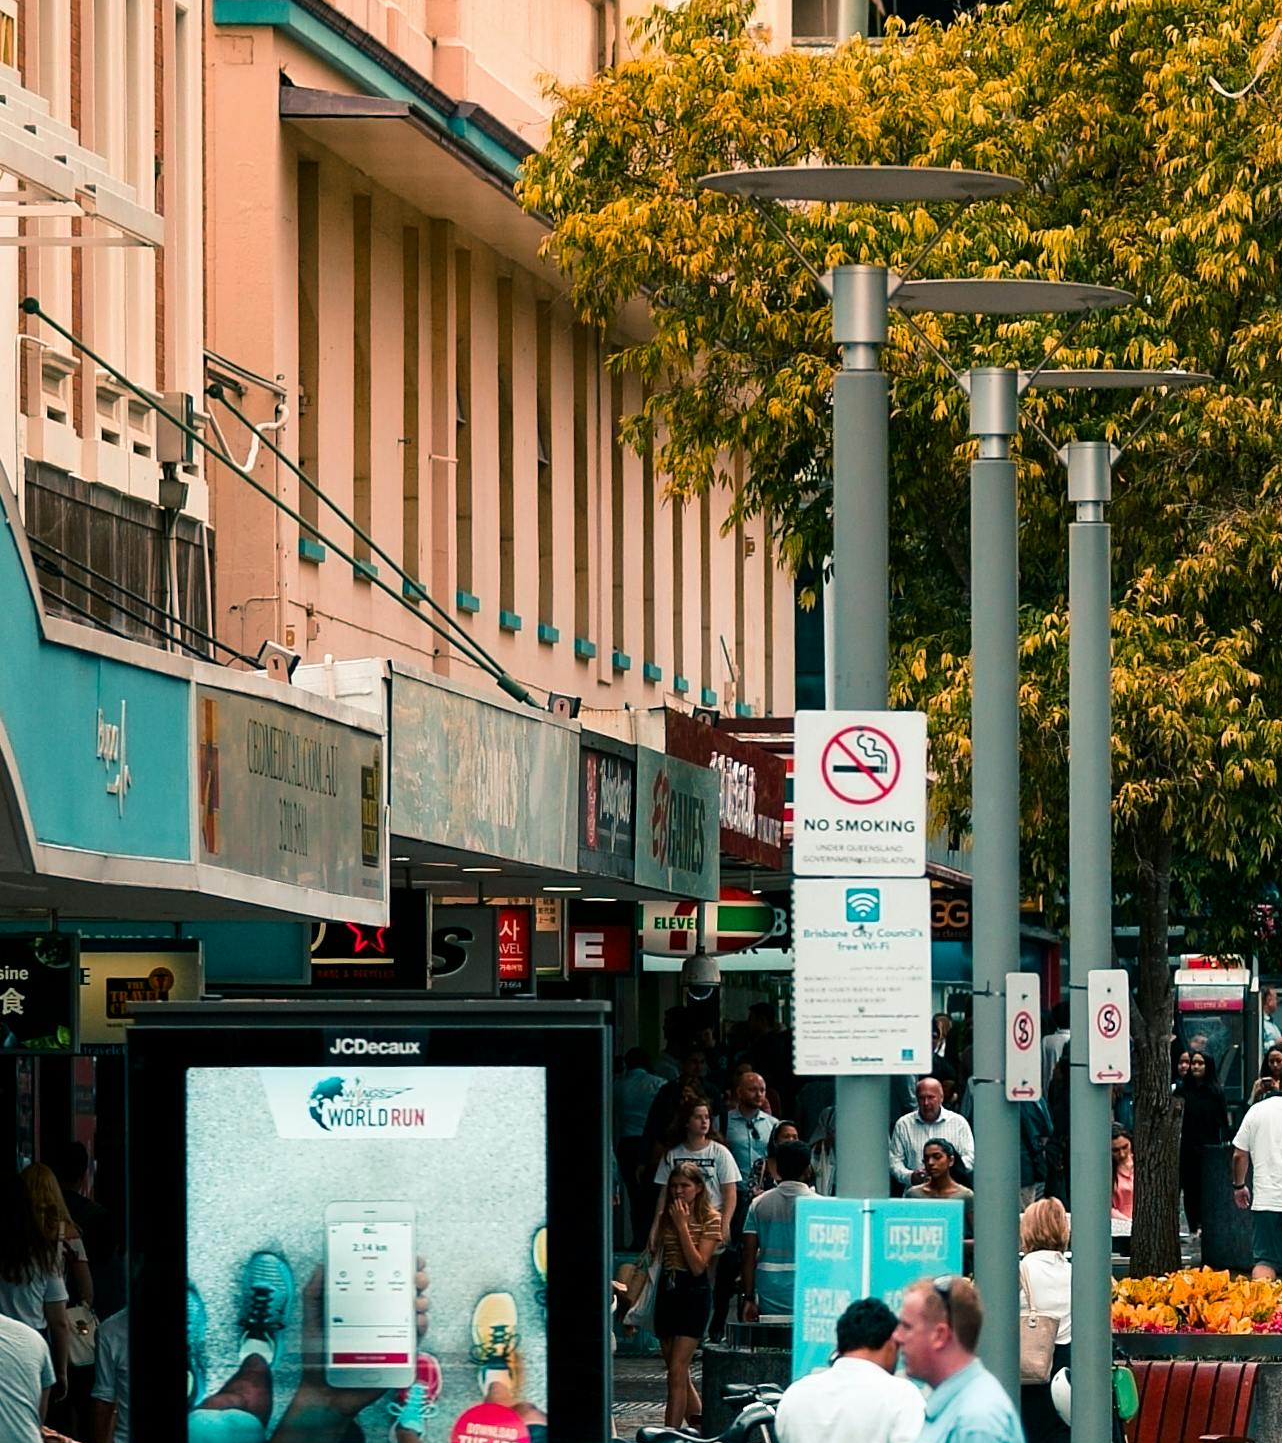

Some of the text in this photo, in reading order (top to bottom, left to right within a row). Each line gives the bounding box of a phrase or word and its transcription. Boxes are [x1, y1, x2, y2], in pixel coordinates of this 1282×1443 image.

[803, 819, 915, 833] NO SMOKING
[815, 844, 904, 853] UNDER QUEENSLAND
[803, 855, 858, 864] GOVERNMEN
[654, 916, 697, 930] ELEVE
[803, 928, 848, 938] Brisbane
[877, 928, 924, 938] Council's
[837, 942, 889, 951] free Wi-Fi
[330, 1038, 421, 1055] JCDecaux
[328, 1108, 425, 1127] WORLD RUN
[352, 1243, 388, 1252] 2.14 km
[465, 1422, 519, 1440] DOWNLOAD
